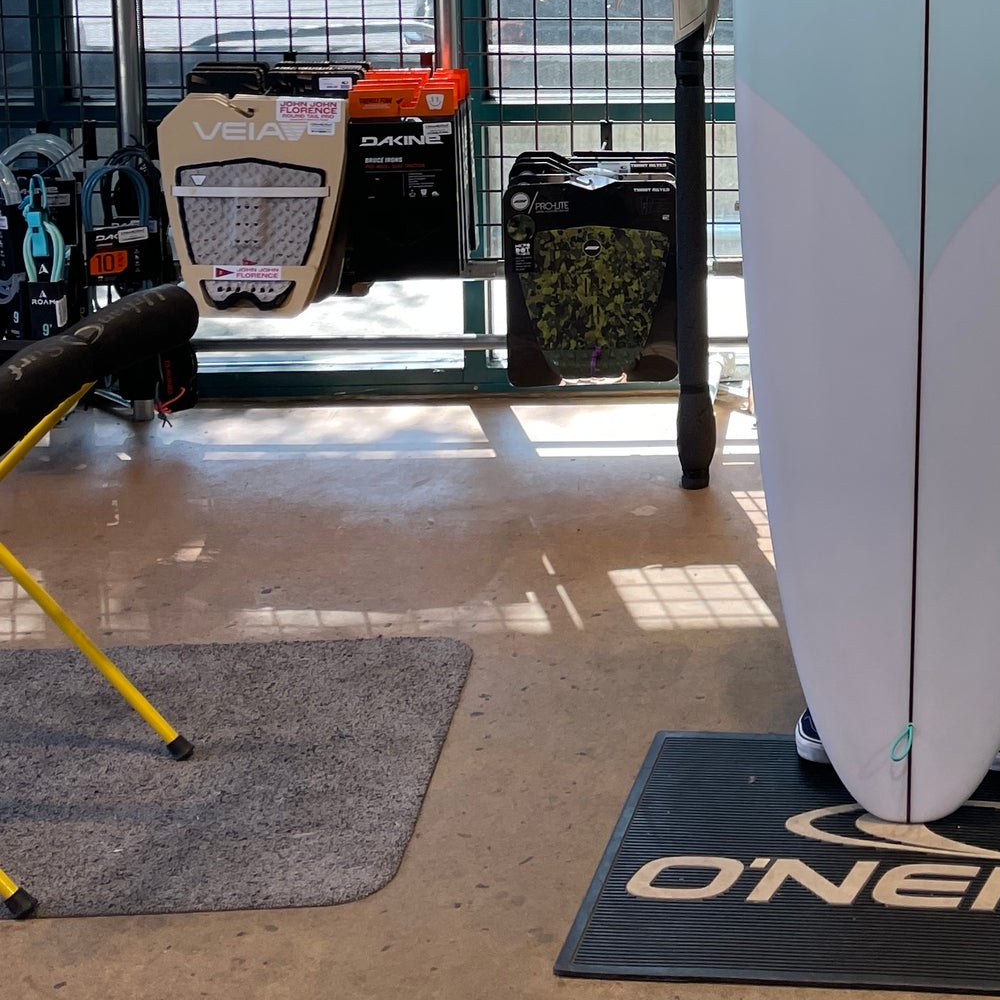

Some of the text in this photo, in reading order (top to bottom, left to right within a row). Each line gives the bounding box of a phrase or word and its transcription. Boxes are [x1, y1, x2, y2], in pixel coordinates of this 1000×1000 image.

[193, 121, 286, 141] VEIA
[359, 135, 444, 147] DAKINE
[95, 253, 115, 273] 10
